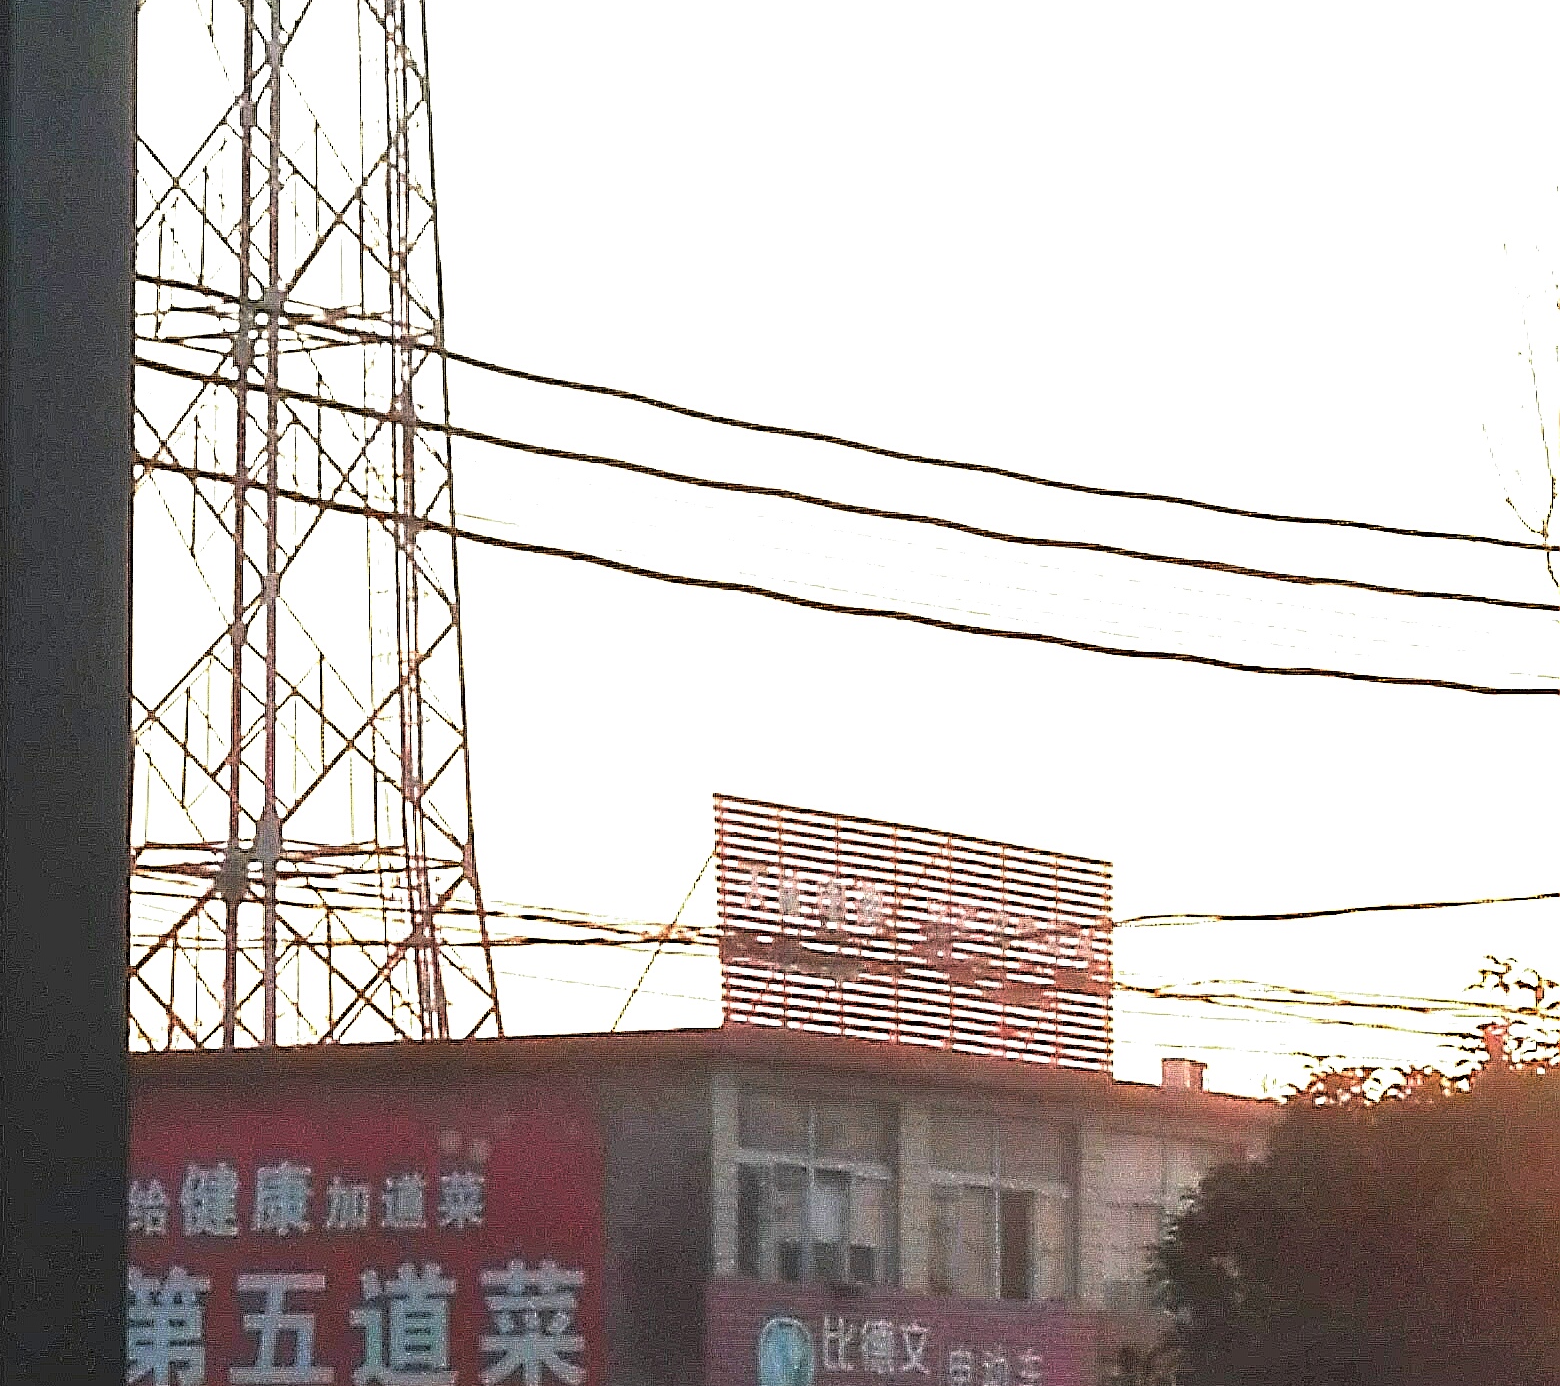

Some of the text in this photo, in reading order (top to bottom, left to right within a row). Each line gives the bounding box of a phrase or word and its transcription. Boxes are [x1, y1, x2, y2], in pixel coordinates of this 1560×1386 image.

[128, 1160, 486, 1238] 给健康加道菜
[822, 1314, 931, 1376] 比德文
